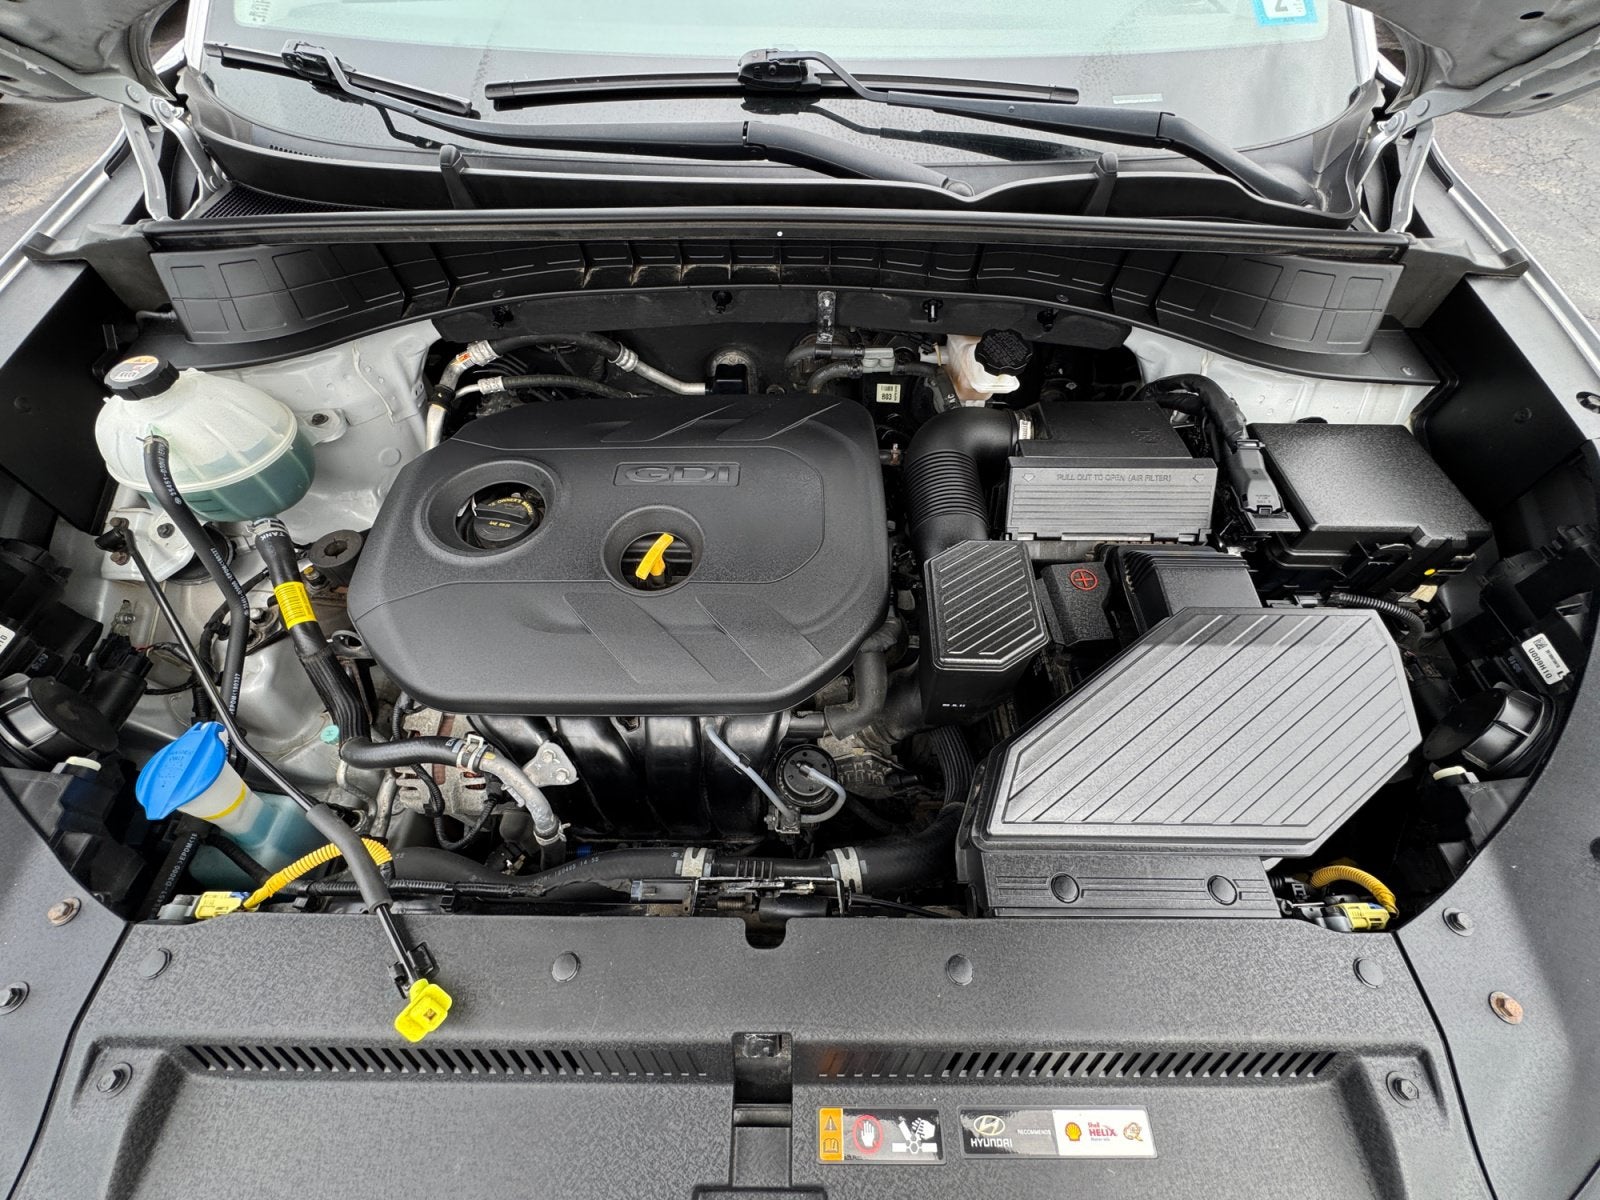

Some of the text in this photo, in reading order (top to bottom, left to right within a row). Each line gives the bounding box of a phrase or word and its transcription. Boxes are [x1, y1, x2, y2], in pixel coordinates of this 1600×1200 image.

[624, 465, 730, 483] GDI
[1105, 474, 1125, 482] OPEN
[260, 531, 285, 541] TANK
[1088, 1127, 1118, 1137] HELIX
[970, 1137, 1013, 1148] HYUNDAI
